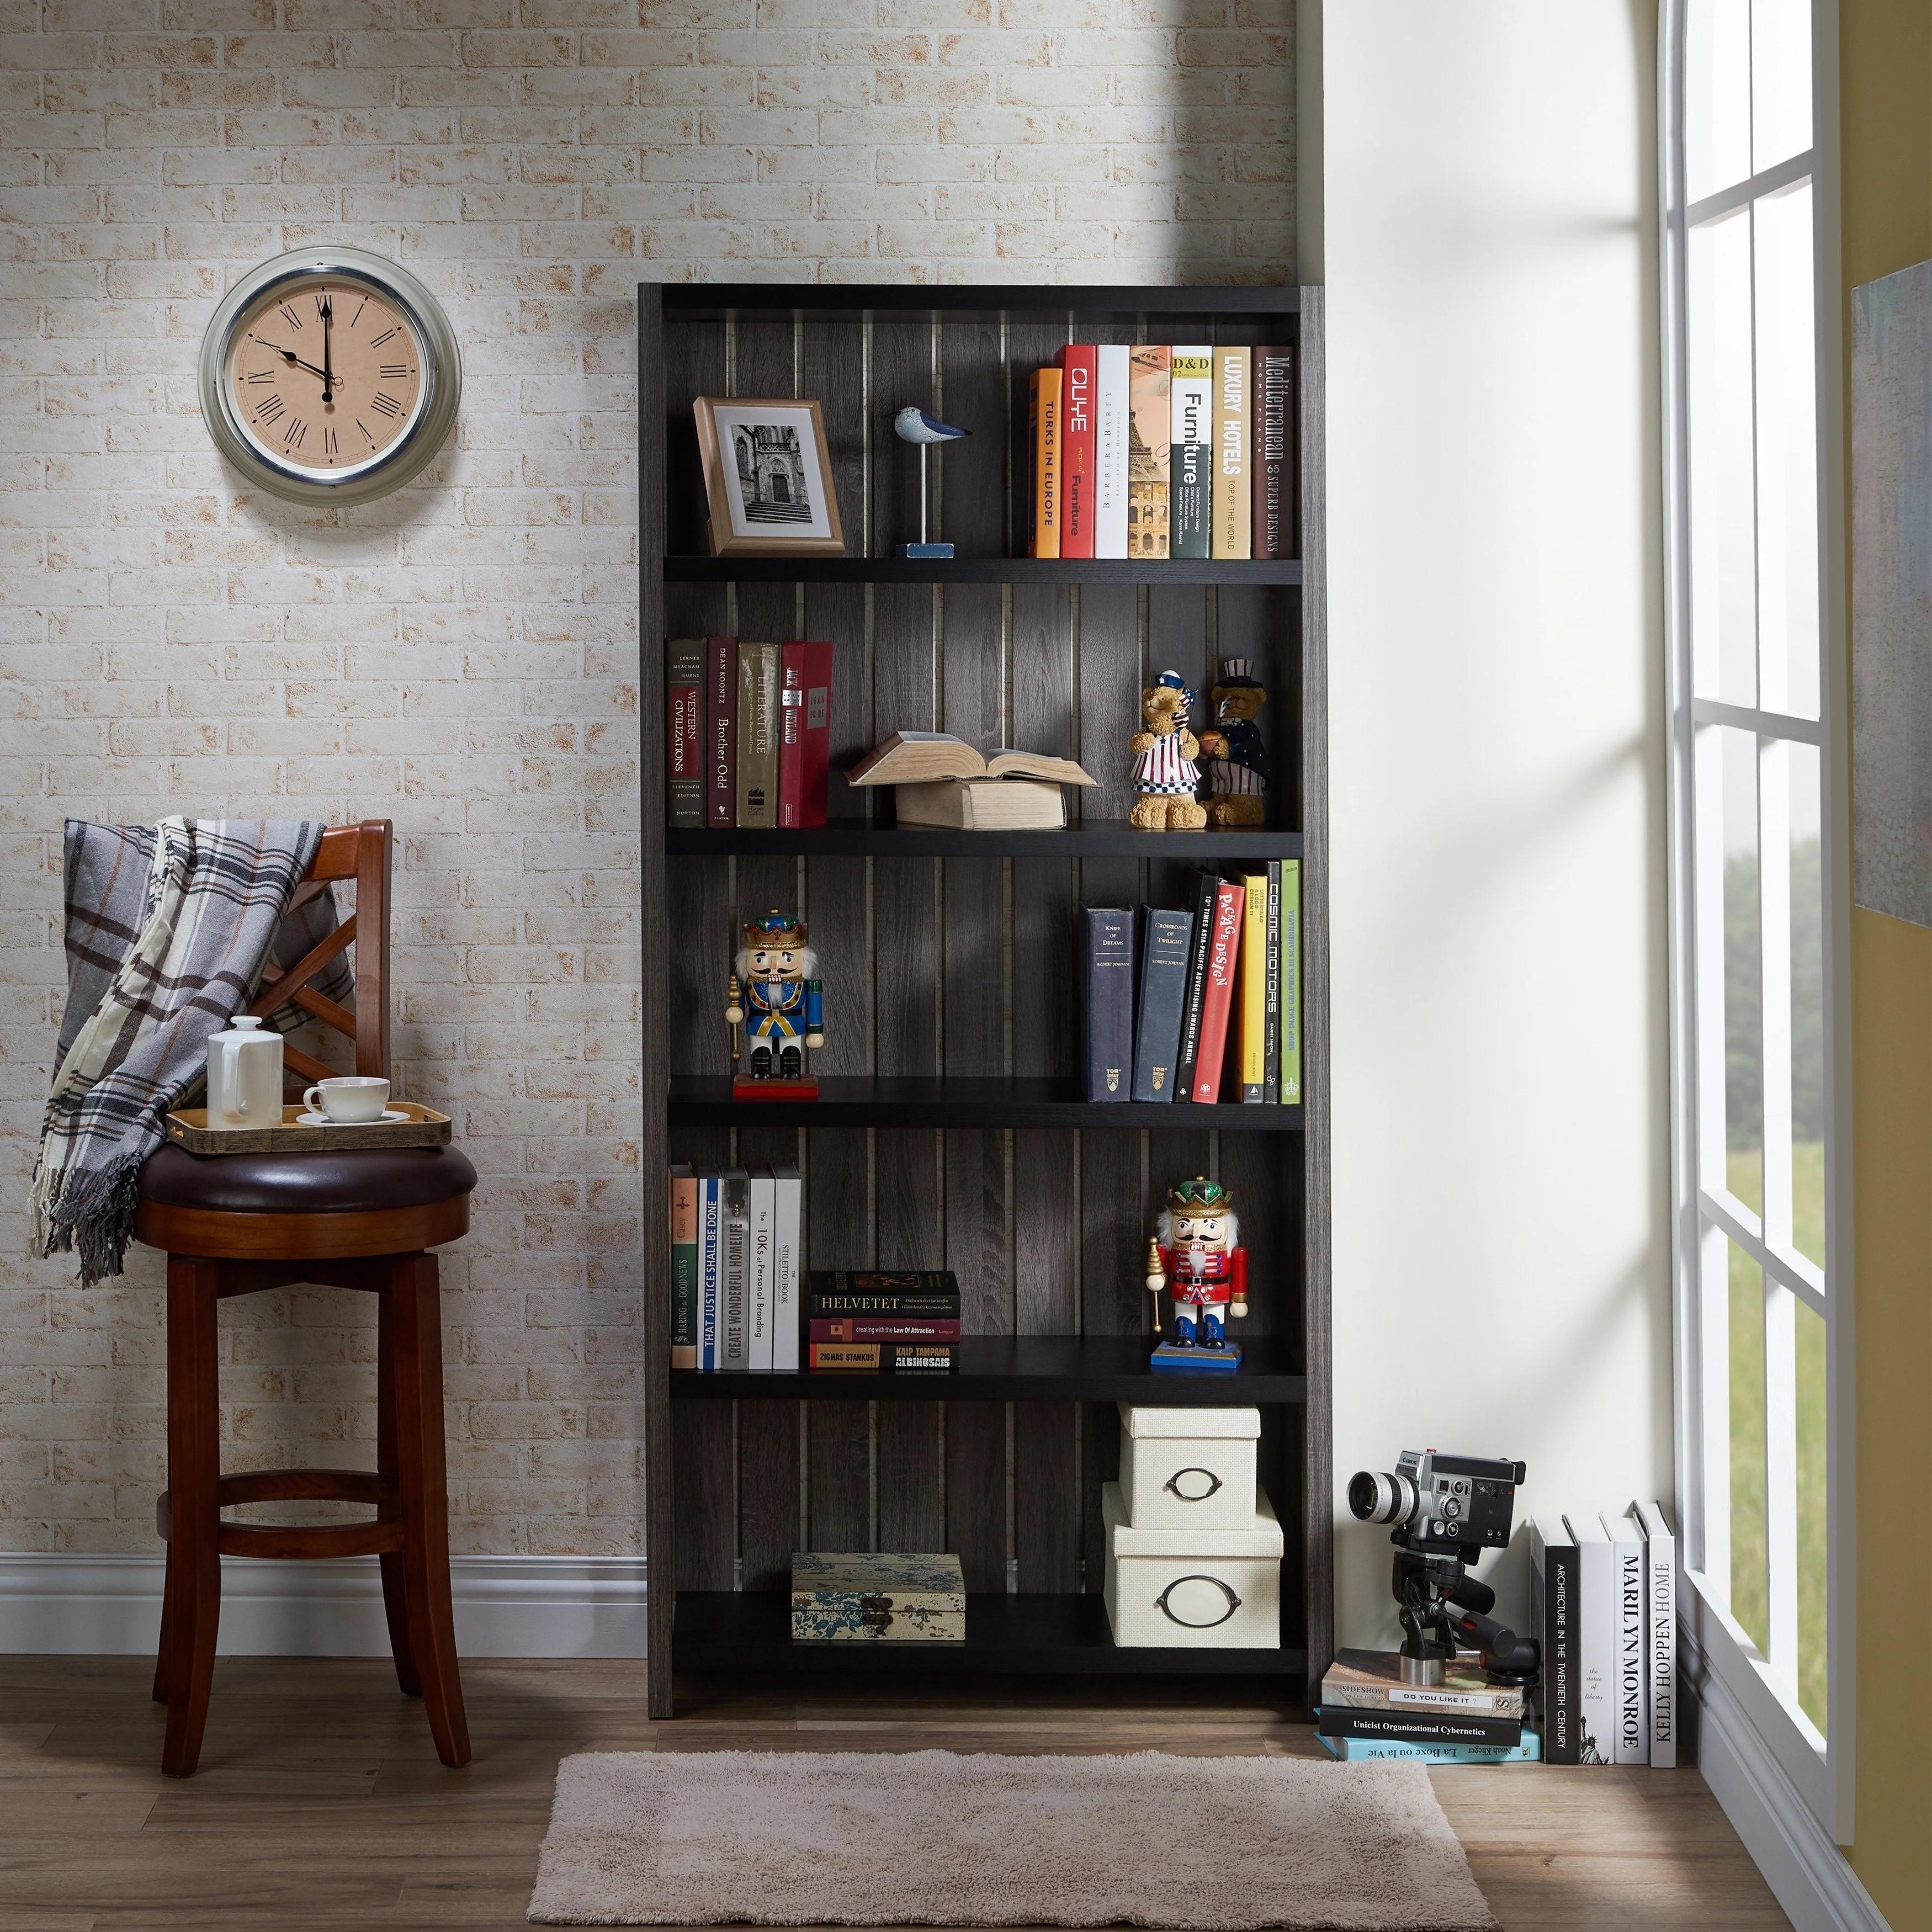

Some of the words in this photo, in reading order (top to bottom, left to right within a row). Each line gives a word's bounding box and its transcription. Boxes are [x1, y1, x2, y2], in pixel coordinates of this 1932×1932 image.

[1223, 356, 1243, 413] LUXURY
[1045, 400, 1054, 445] TURKS
[1265, 357, 1291, 460] Mediterranean
[1183, 394, 1202, 484] Furniture
[1223, 421, 1241, 475] HOTELS
[1045, 452, 1053, 466] IN
[1103, 443, 1111, 508] BARBERA
[1267, 464, 1280, 474] 65
[1044, 473, 1053, 526] EUROPE
[1071, 475, 1081, 536] Furniture
[1228, 497, 1235, 505] OF
[1267, 476, 1279, 510] SUPERB
[1267, 513, 1278, 552] DESIGNS
[786, 667, 798, 687] JACK
[687, 691, 696, 740] WESTERN
[757, 676, 767, 753] LITERATURE
[810, 696, 825, 705] LEAN
[675, 700, 684, 772] CIVILIZATIONS
[718, 719, 729, 761] Brother
[784, 708, 798, 744] WEYLAND
[717, 765, 728, 789] Odd
[1155, 922, 1188, 931] CROSSROADS
[1202, 908, 1210, 927] TIMES
[1219, 893, 1236, 940] PACKAGE
[1269, 883, 1278, 942] COSMIC
[1197, 928, 1208, 970] ASIA-PACIFIC
[1212, 942, 1228, 986] DESIGN
[1192, 972, 1202, 1012] ADVERTISING
[1268, 946, 1278, 1013] MOTORS
[1188, 1013, 1197, 1039] AWARDS
[1185, 1040, 1194, 1064] ANNUAL
[677, 1218, 688, 1238] Casey
[707, 1201, 716, 1227] DONE
[707, 1229, 716, 1240] BE
[729, 1224, 742, 1267] HOMELIFE
[678, 1259, 687, 1278] NEWS
[706, 1243, 716, 1272] SHALL
[678, 1279, 687, 1298] GOOD
[705, 1275, 715, 1317] JUSTICE
[728, 1270, 742, 1324] WONDERFUL
[757, 1265, 765, 1299] Personal
[754, 1303, 765, 1337] Branding
[821, 1297, 900, 1309] HELVETET
[704, 1320, 714, 1347] THAT
[728, 1327, 741, 1358] CREATE
[820, 1353, 843, 1361] ZIGMAS
[846, 1354, 874, 1362] STANKUS
[895, 1347, 914, 1356] KAIP
[915, 1347, 950, 1356] TAMPAMA
[895, 1357, 950, 1367] ALBINOSAIS
[1557, 1564, 1565, 1626] ARCHITECTURE
[1623, 1556, 1639, 1653] MARILYN
[1655, 1563, 1670, 1613] HOME
[1557, 1630, 1565, 1638] IN
[1557, 1643, 1565, 1658] THE
[1655, 1617, 1670, 1687] HOPPEN
[1342, 1685, 1385, 1695] SIDESHOW
[1557, 1662, 1566, 1706] TWENTIETH
[1585, 1693, 1603, 1701] liberty
[1623, 1658, 1638, 1749] MONROE
[1656, 1691, 1671, 1743] KELLY
[1353, 1720, 1381, 1730] Unicist
[1383, 1722, 1439, 1733] Organizational
[1440, 1726, 1485, 1736] Cybernetics
[1557, 1710, 1566, 1749] CENTURY
[1368, 1749, 1384, 1759] Vie
[1388, 1749, 1397, 1758] la
[1415, 1749, 1440, 1758] Boxe
[1444, 1748, 1457, 1757] La
[1468, 1745, 1490, 1756] Klieger
[1492, 1747, 1512, 1755] Noah
